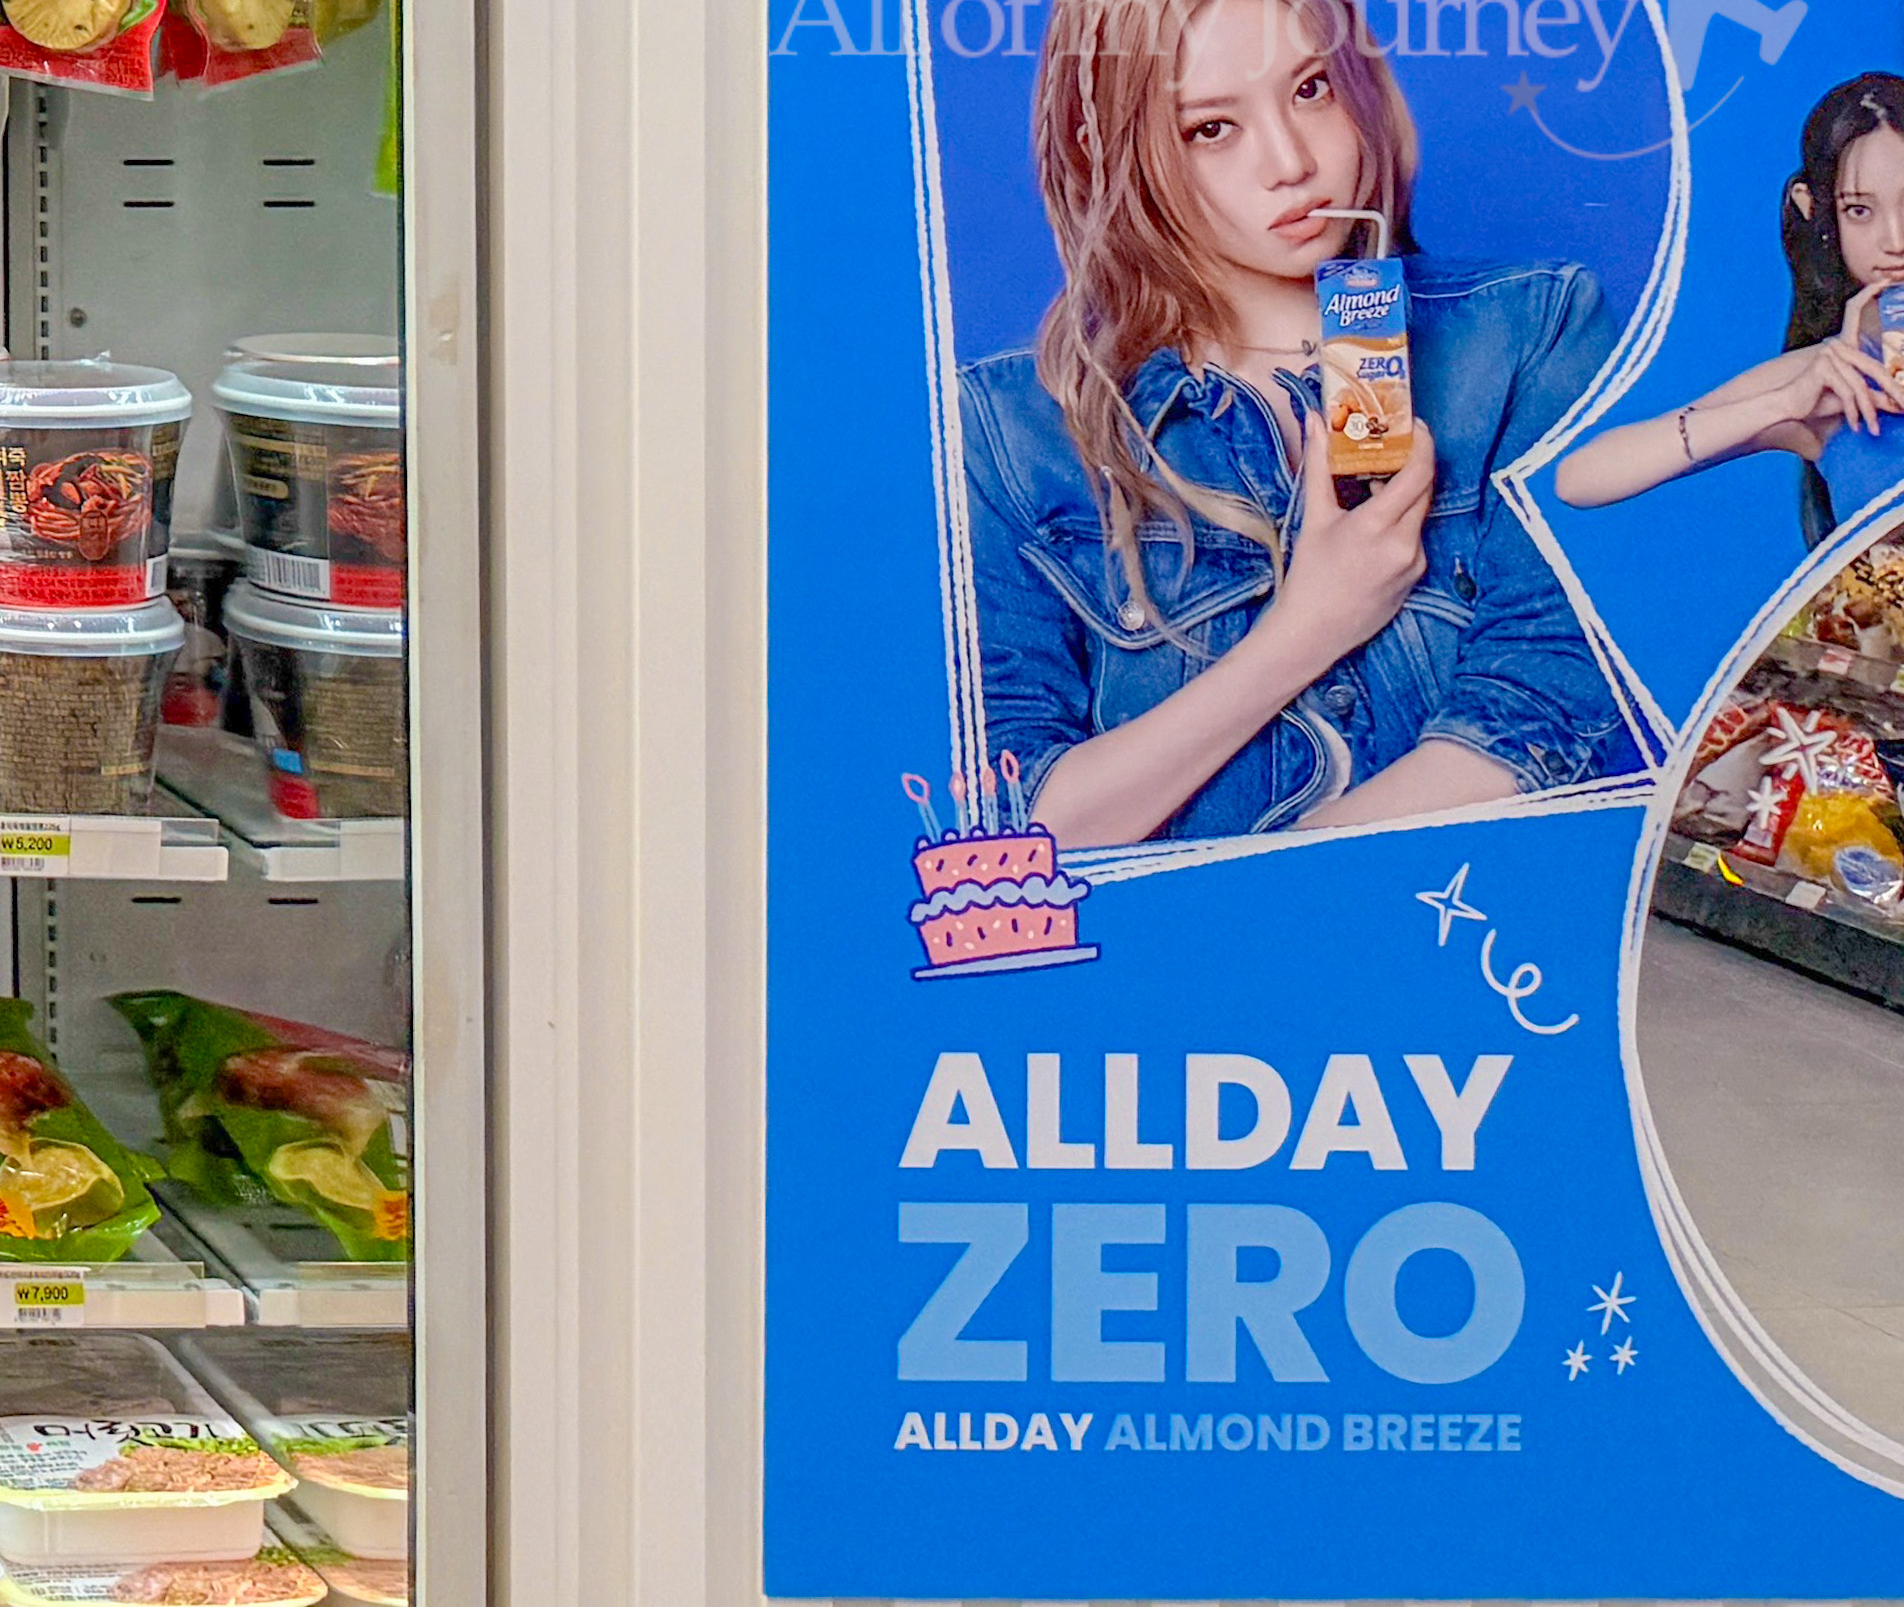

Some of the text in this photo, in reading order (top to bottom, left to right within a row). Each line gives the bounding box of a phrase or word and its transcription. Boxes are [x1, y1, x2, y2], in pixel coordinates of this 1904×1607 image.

[1324, 284, 1400, 315] Almond
[1340, 305, 1390, 327] Breeze
[898, 1052, 1514, 1170] ALLDAY
[897, 1202, 1526, 1384] ZERO
[894, 1412, 1522, 1453] ALLDAY ALMOND BREEZE
